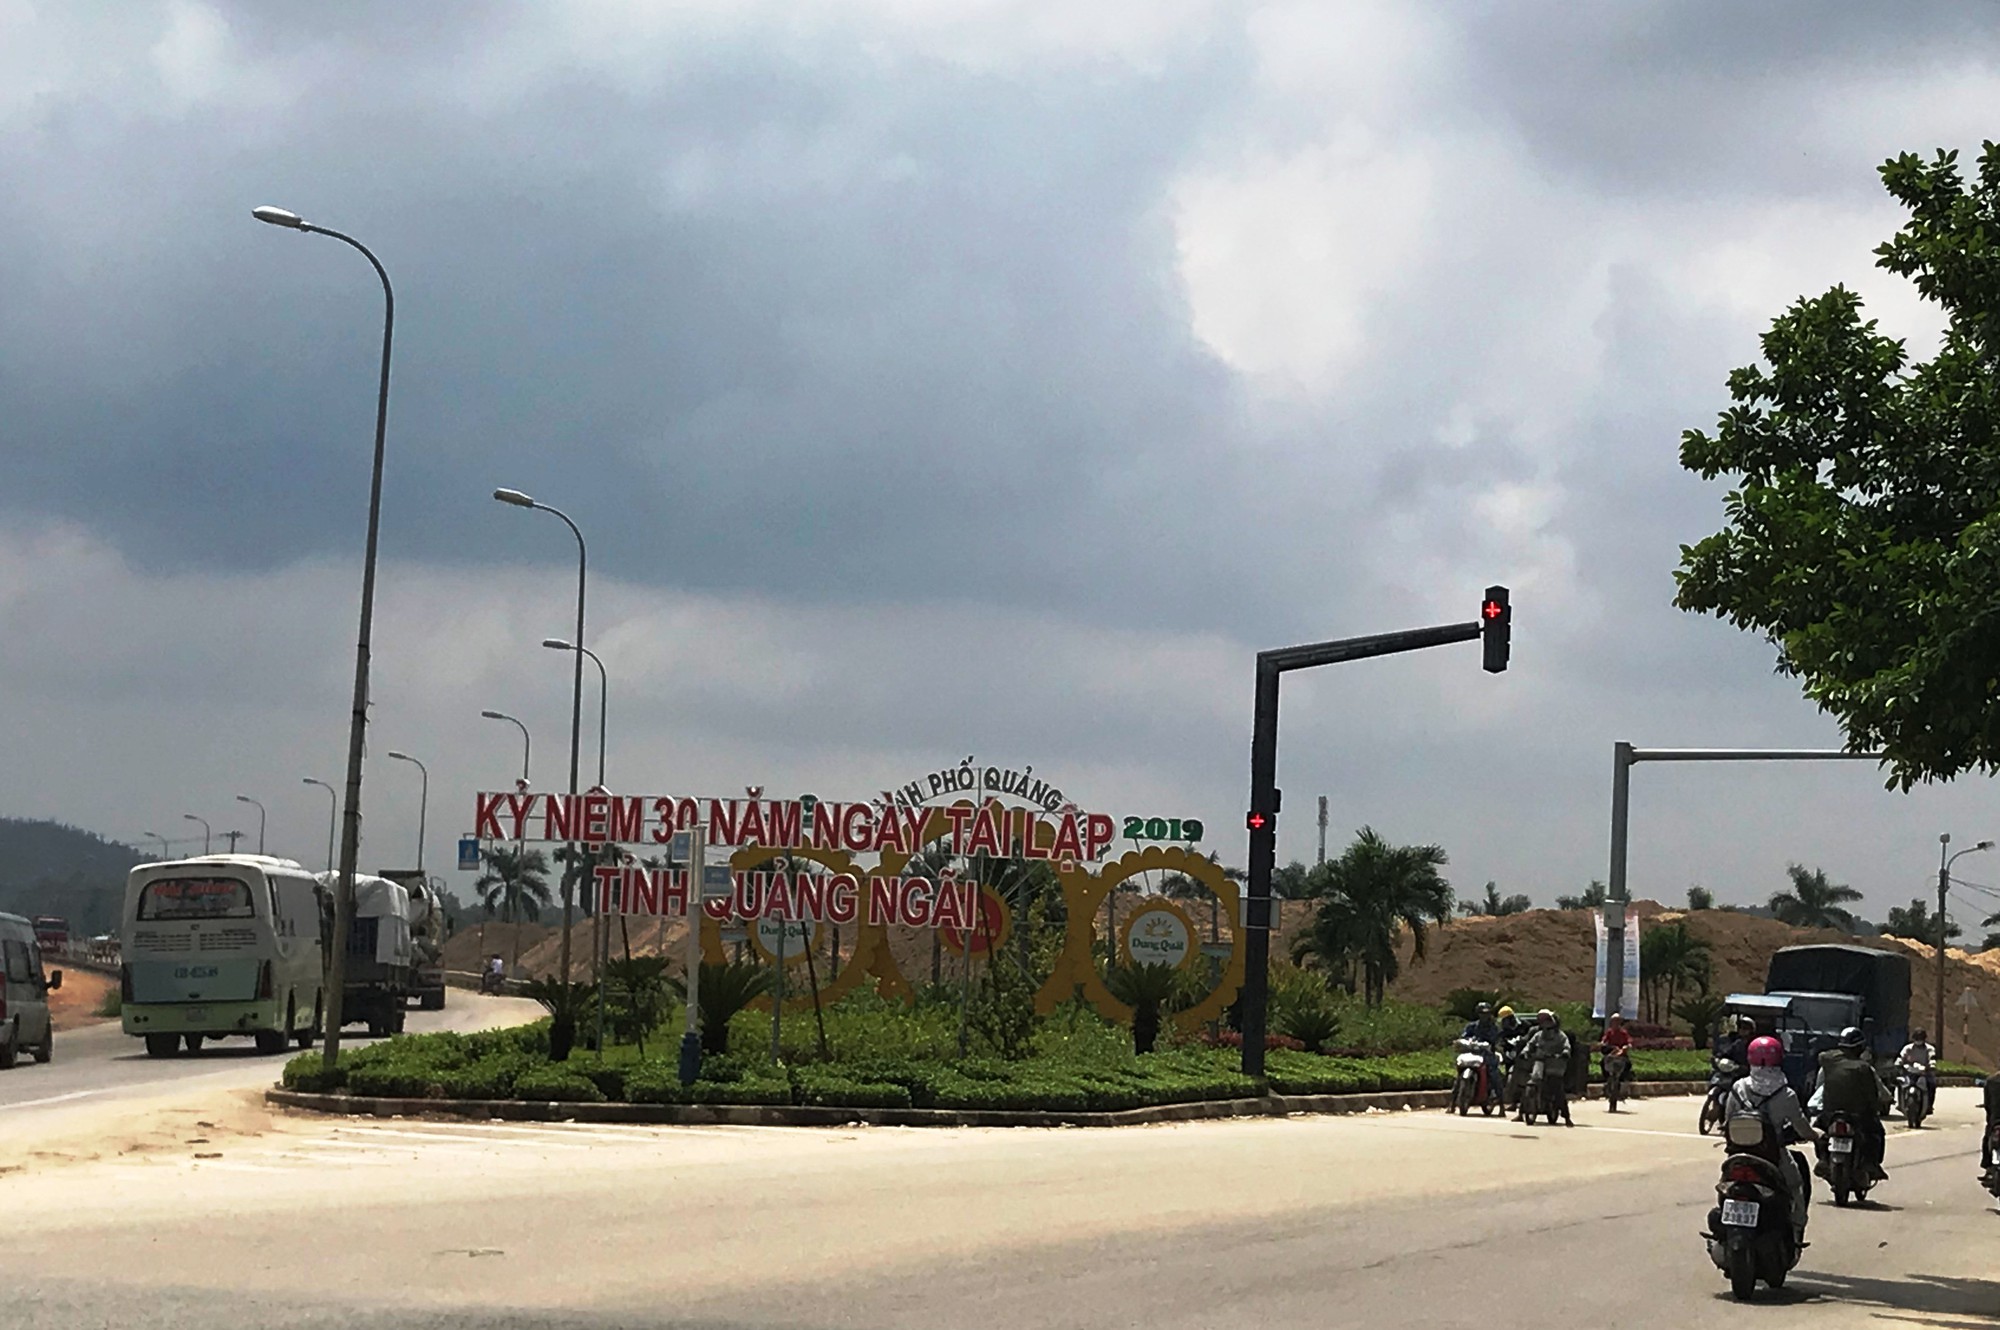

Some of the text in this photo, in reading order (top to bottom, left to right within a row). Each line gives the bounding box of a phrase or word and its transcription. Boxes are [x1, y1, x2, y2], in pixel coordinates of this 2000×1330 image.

[928, 756, 1062, 811] PHỐ QUẢNG
[544, 785, 645, 854] NIỆM
[652, 795, 699, 844] 30
[709, 786, 803, 848] NĂM
[812, 790, 934, 854] NGÀY
[944, 796, 1014, 858] TÁI
[1023, 803, 1116, 872] LẬP
[1123, 816, 1204, 842] 2019
[594, 854, 690, 917] TỈNH
[868, 867, 977, 931] NGÃI
